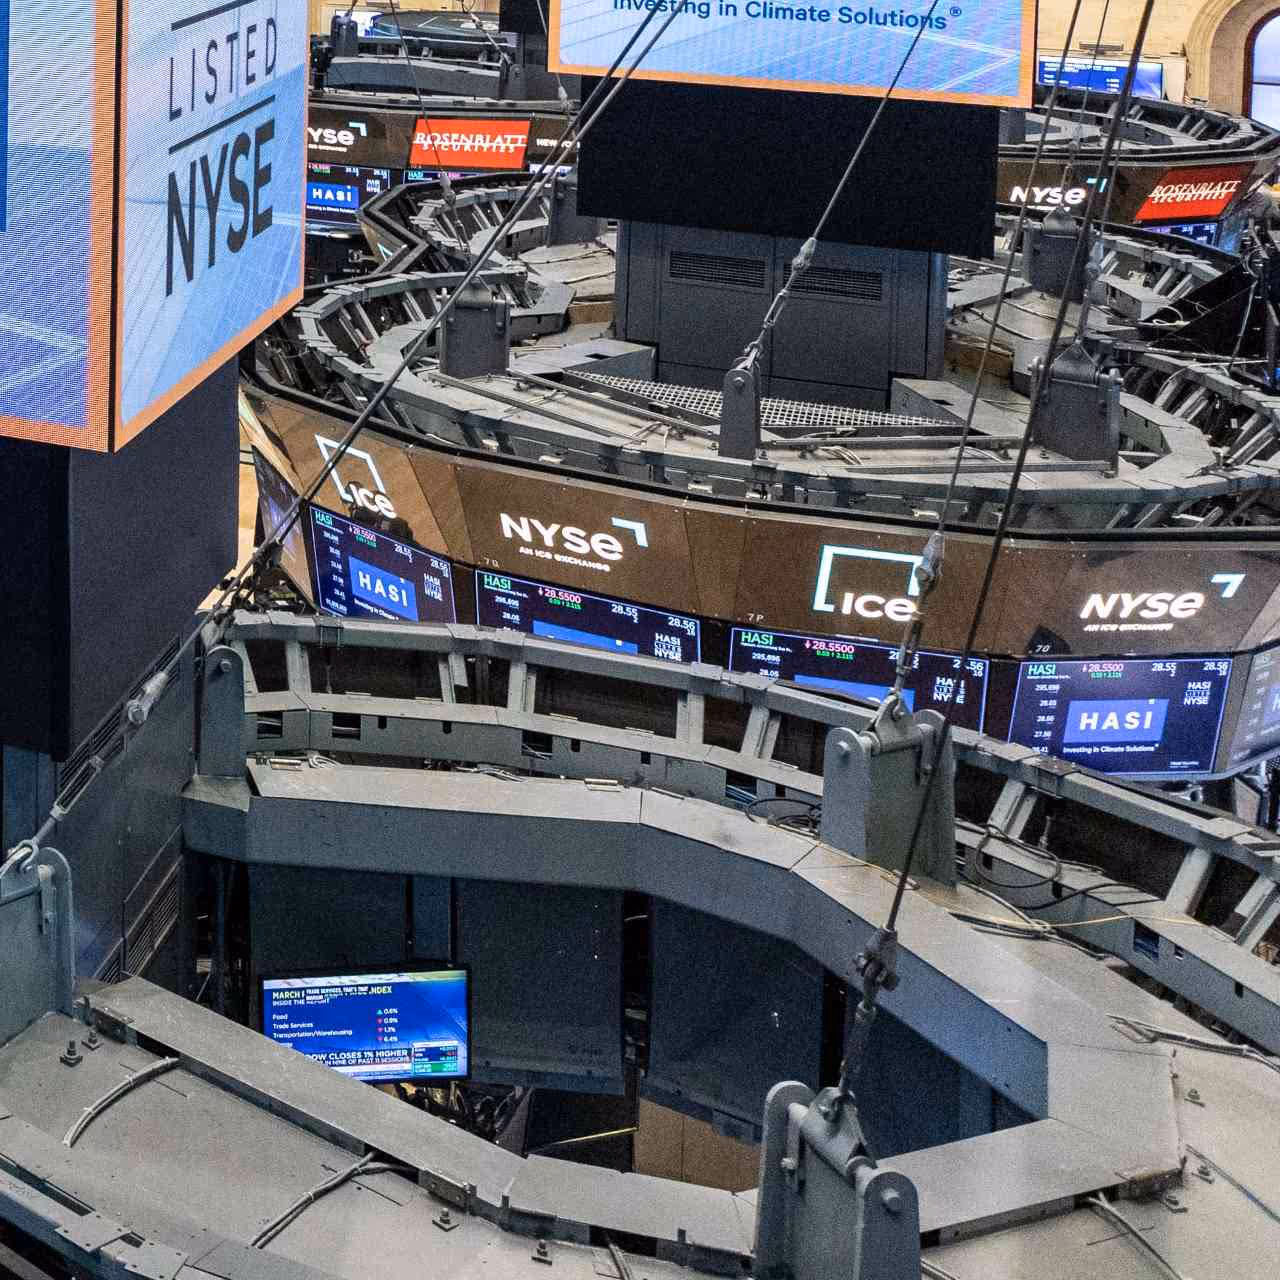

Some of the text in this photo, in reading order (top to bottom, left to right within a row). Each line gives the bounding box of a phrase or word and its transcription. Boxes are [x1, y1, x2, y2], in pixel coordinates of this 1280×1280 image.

[719, 0, 737, 17] in
[745, 0, 831, 22] Climate
[168, 16, 278, 122] LISTED
[414, 132, 528, 148] ROSENBLATT
[312, 186, 352, 202] HASI
[1148, 180, 1241, 199] ROSENBLATT
[165, 117, 275, 298] NYSE
[358, 570, 408, 608] HASI
[484, 574, 695, 631] HASI 28.5500 28.55 28.56
[655, 633, 681, 646] HASI
[741, 631, 855, 654] HASI 28.5500
[654, 649, 682, 662] NYSE
[1028, 664, 1057, 675] HASI
[1089, 663, 1124, 673] 28.5500
[1152, 662, 1176, 672] 28.55
[1188, 681, 1211, 690] HASI
[1183, 696, 1209, 705] NYSE
[1079, 711, 1152, 730] HASI
[1063, 745, 1125, 755] Investing Climate
[272, 990, 301, 1000] MARCH
[328, 1049, 408, 1060] CLOSES HIGHER
